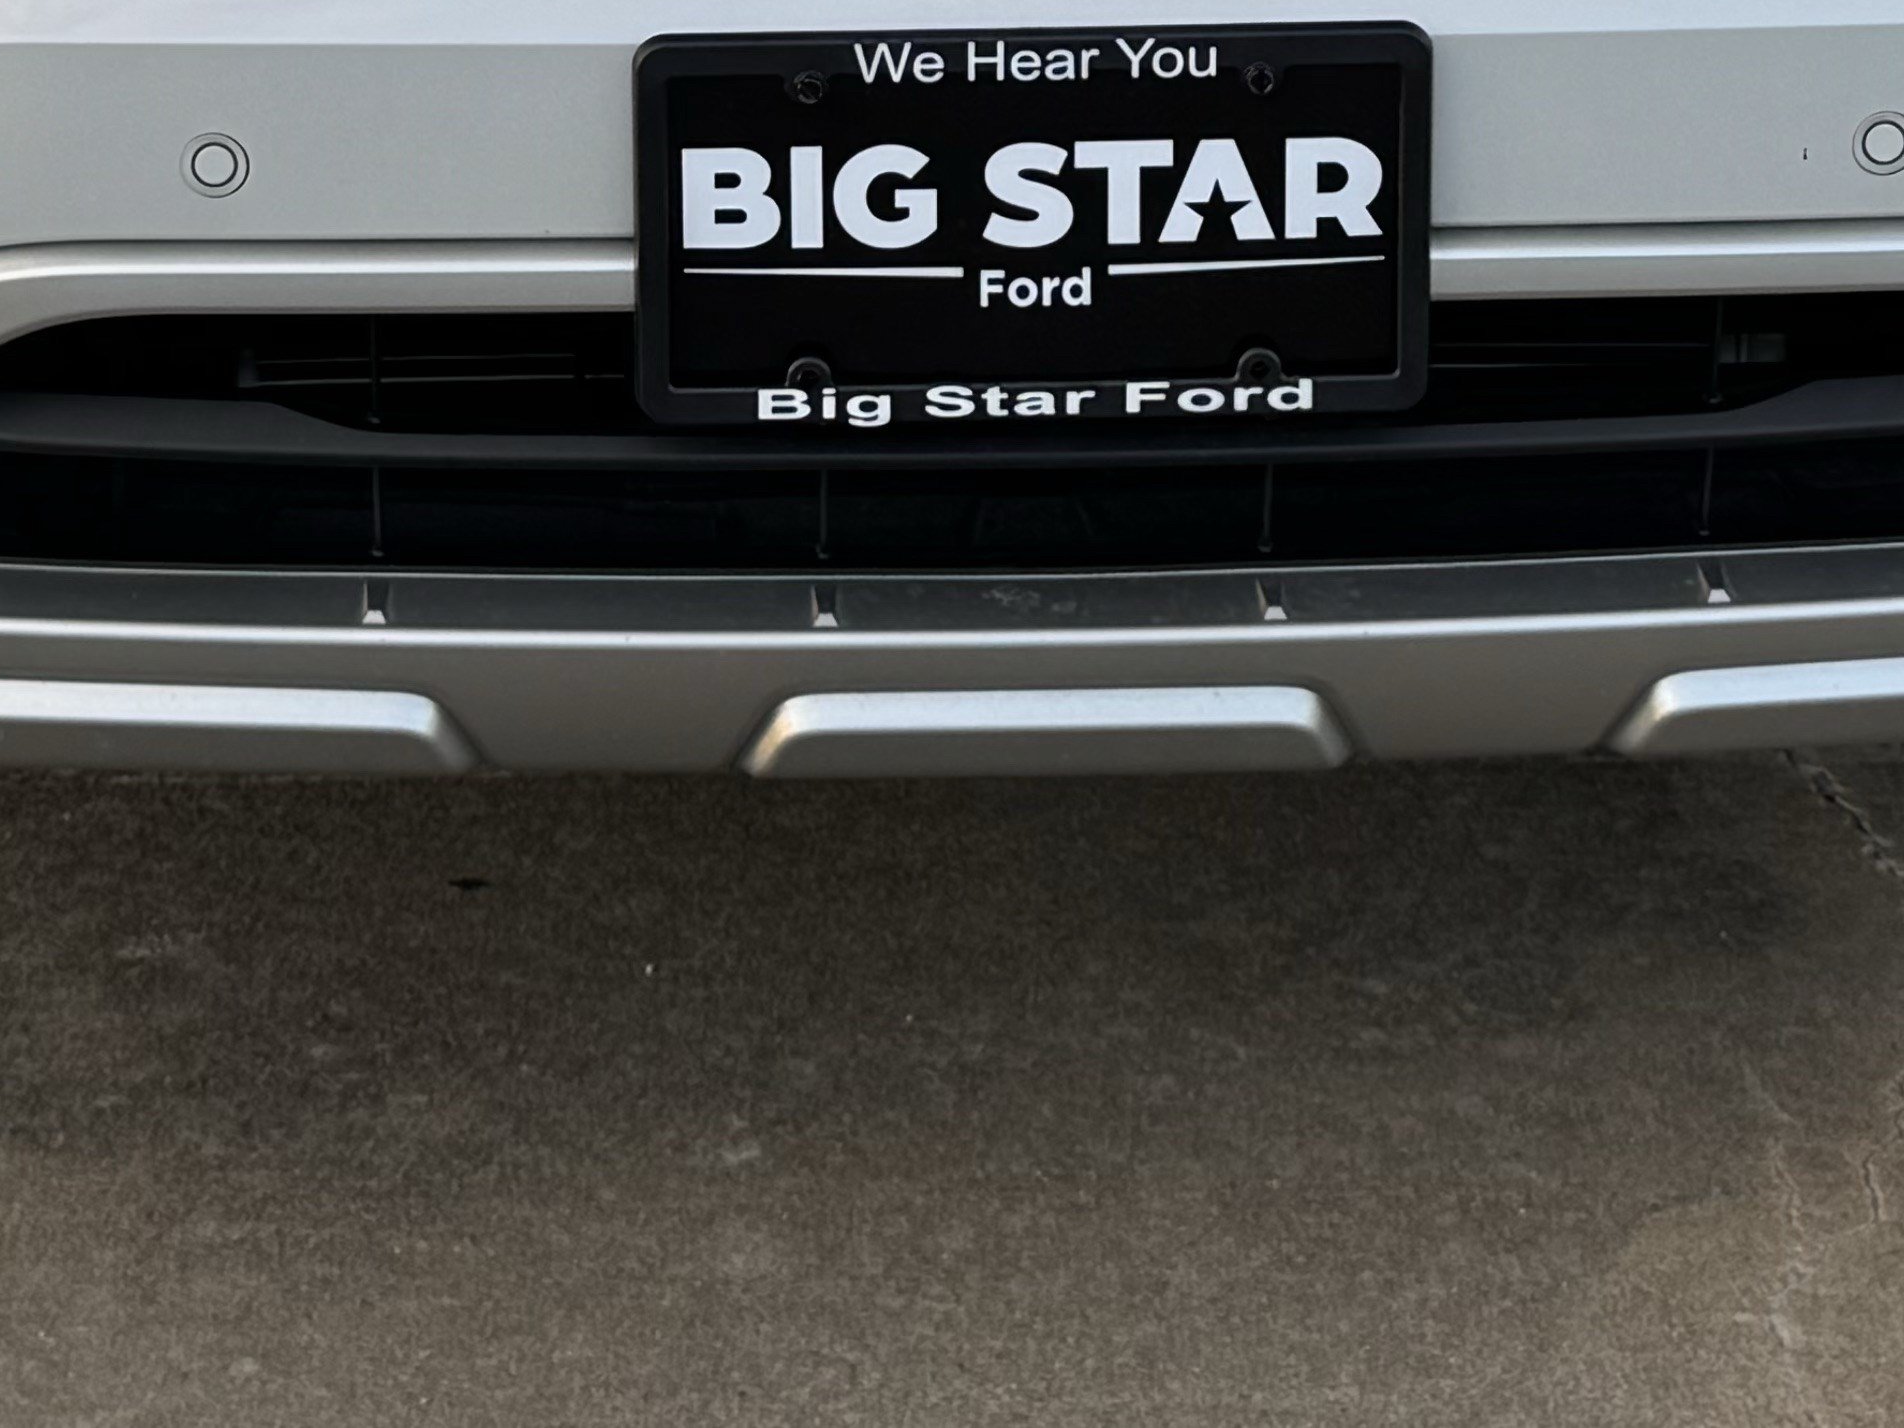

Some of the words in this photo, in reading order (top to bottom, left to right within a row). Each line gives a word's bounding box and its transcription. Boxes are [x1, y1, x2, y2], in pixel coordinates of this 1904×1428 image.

[854, 41, 945, 83] We
[967, 40, 1100, 82] Hear
[1115, 37, 1218, 79] You
[681, 144, 938, 249] BIG
[982, 137, 1383, 248] STAR
[979, 266, 1093, 308] Ford
[756, 387, 892, 427] Big
[924, 385, 1096, 418] Star
[1125, 378, 1313, 413] Ford
